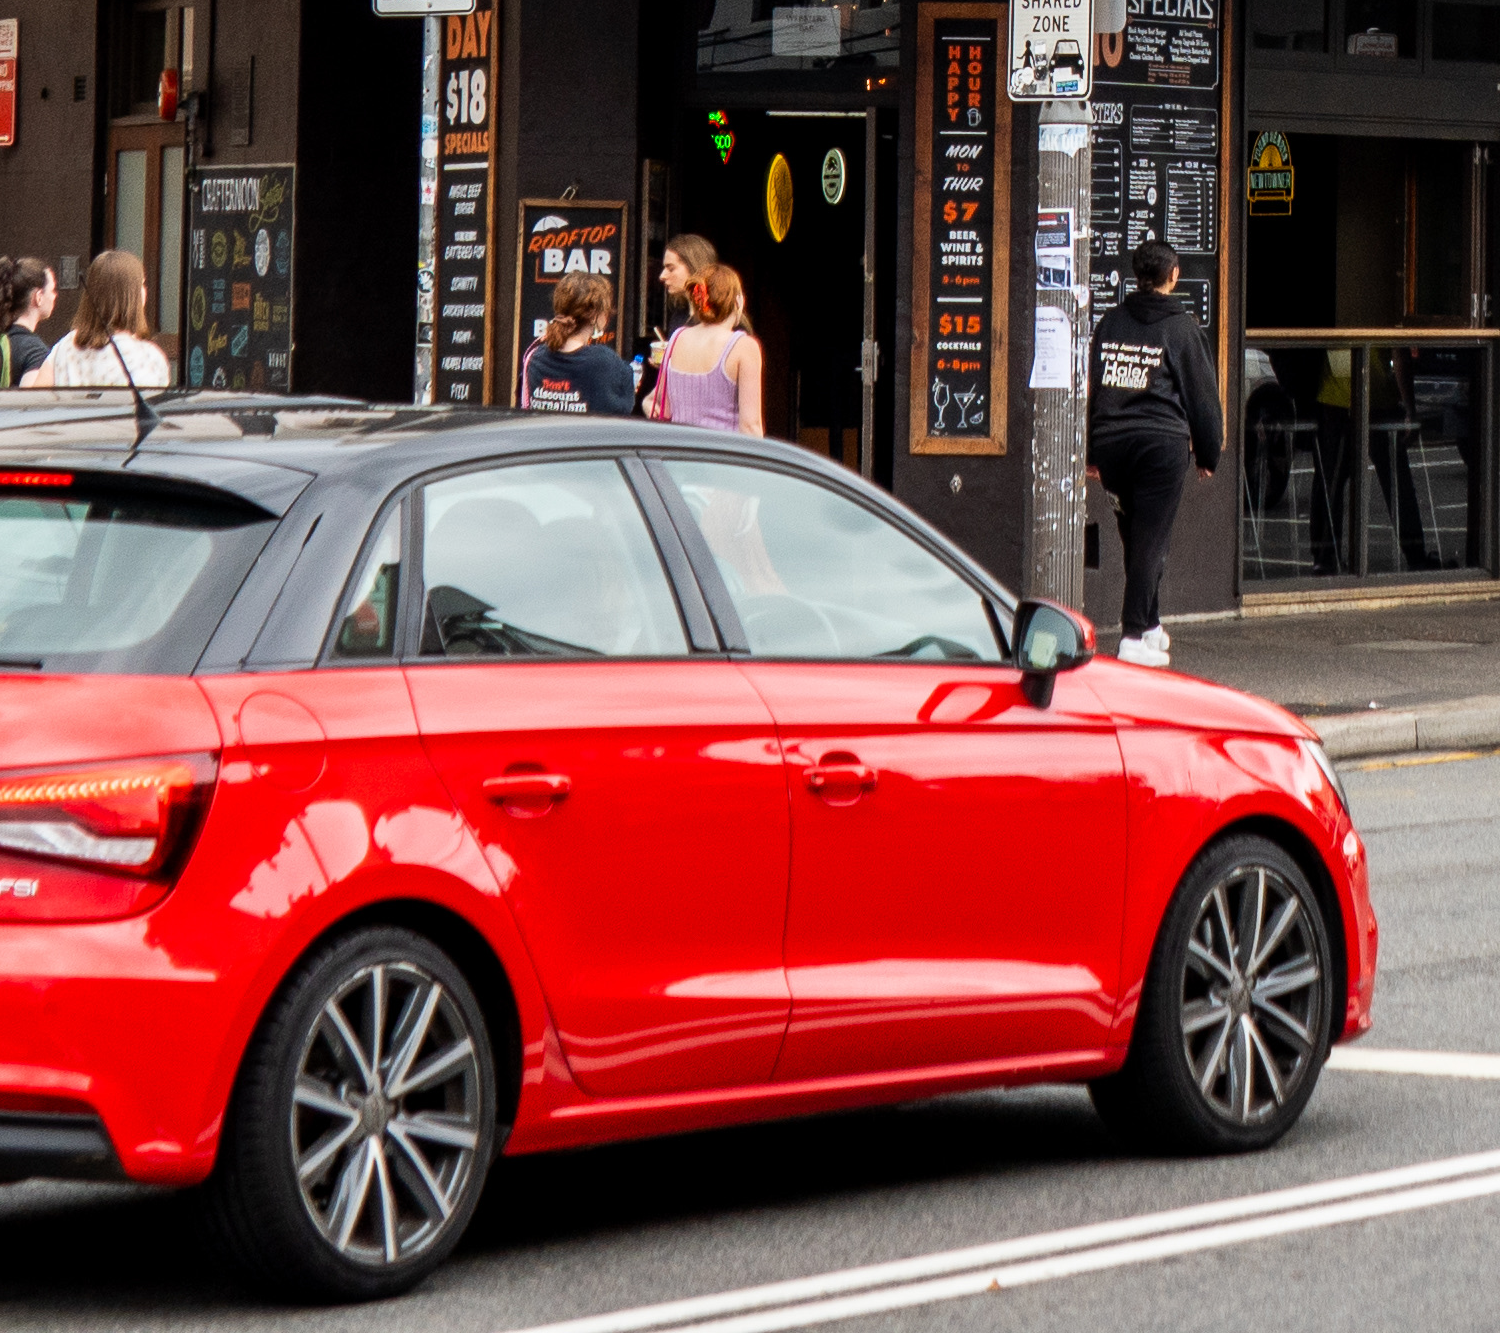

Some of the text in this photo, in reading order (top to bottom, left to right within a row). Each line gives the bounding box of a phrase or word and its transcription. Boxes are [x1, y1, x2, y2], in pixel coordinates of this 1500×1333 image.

[445, 11, 492, 61] DAY
[1032, 15, 1070, 33] ZONE
[948, 45, 961, 123] HAPPY
[968, 45, 982, 108] HOUR
[445, 68, 488, 127] $18
[443, 131, 490, 155] SPECIALS
[945, 144, 982, 160] MON
[956, 162, 970, 172] TO
[943, 176, 984, 192] THUR
[943, 199, 980, 224] $7
[528, 223, 617, 254] ROOFTOP
[940, 242, 984, 254] WINE &
[543, 247, 612, 275] BAR
[941, 255, 984, 267] SPIRITS
[939, 312, 982, 337] $15
[936, 341, 982, 351] COCKTAILS
[533, 387, 580, 403] discount
